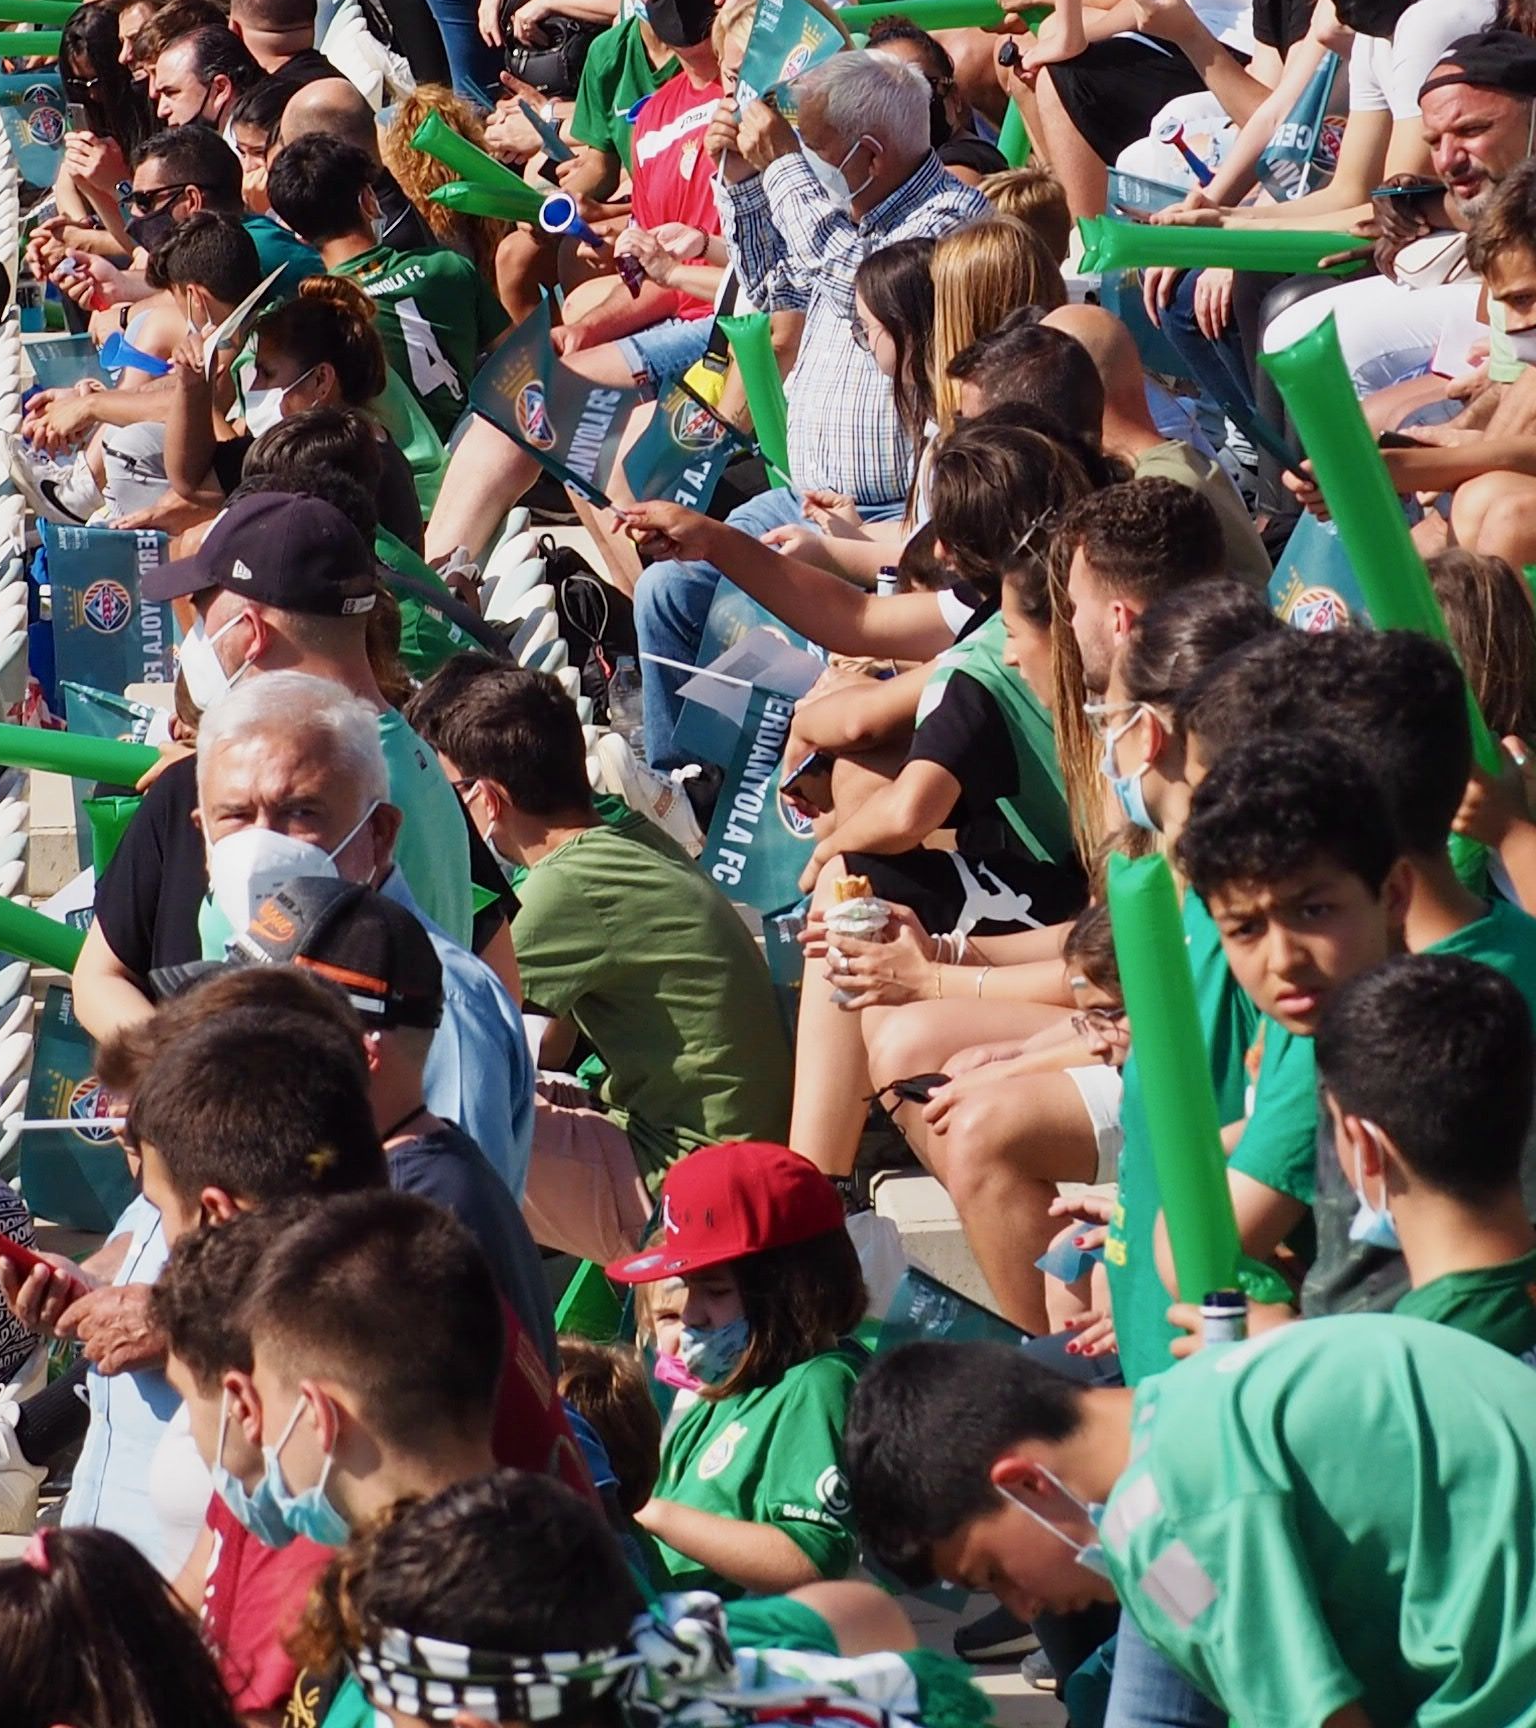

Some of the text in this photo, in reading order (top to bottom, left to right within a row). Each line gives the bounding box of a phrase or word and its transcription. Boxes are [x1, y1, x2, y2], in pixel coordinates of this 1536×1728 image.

[404, 264, 426, 282] FC
[394, 296, 464, 401] 4
[711, 692, 794, 886] ERDANYOLA FC
[805, 1509, 820, 1521] de
